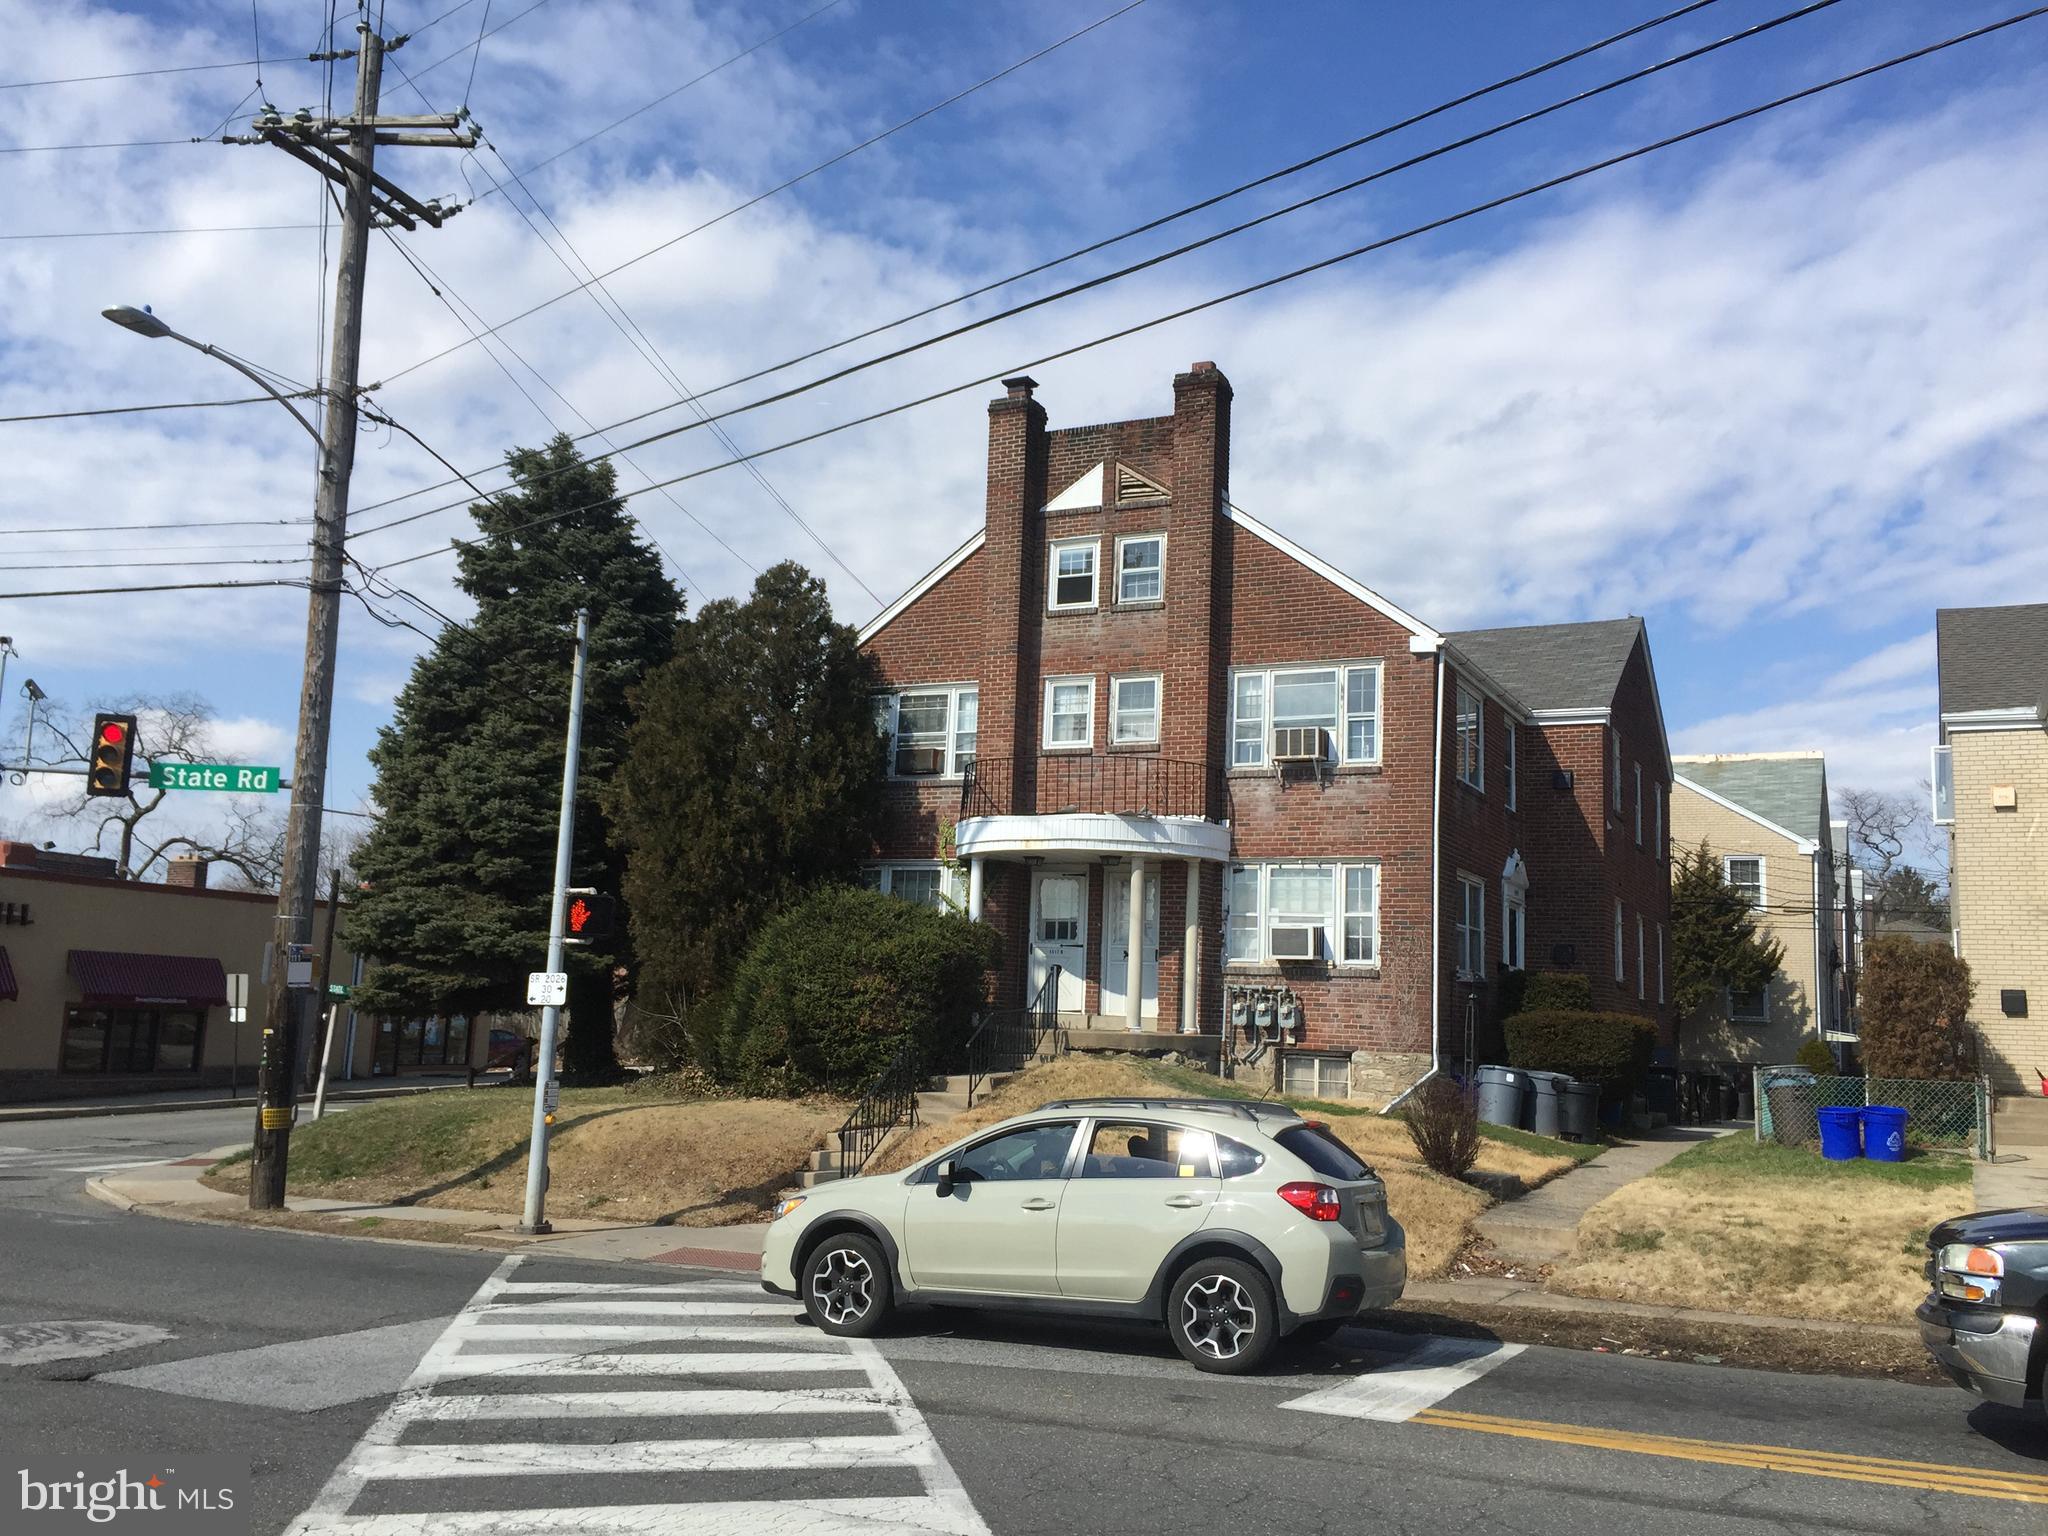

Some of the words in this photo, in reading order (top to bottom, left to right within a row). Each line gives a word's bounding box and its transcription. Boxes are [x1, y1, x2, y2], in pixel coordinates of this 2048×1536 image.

[162, 766, 228, 788] State
[237, 769, 268, 790] Rd
[530, 974, 541, 984] SR
[545, 974, 566, 984] 2026
[541, 984, 553, 994] 30
